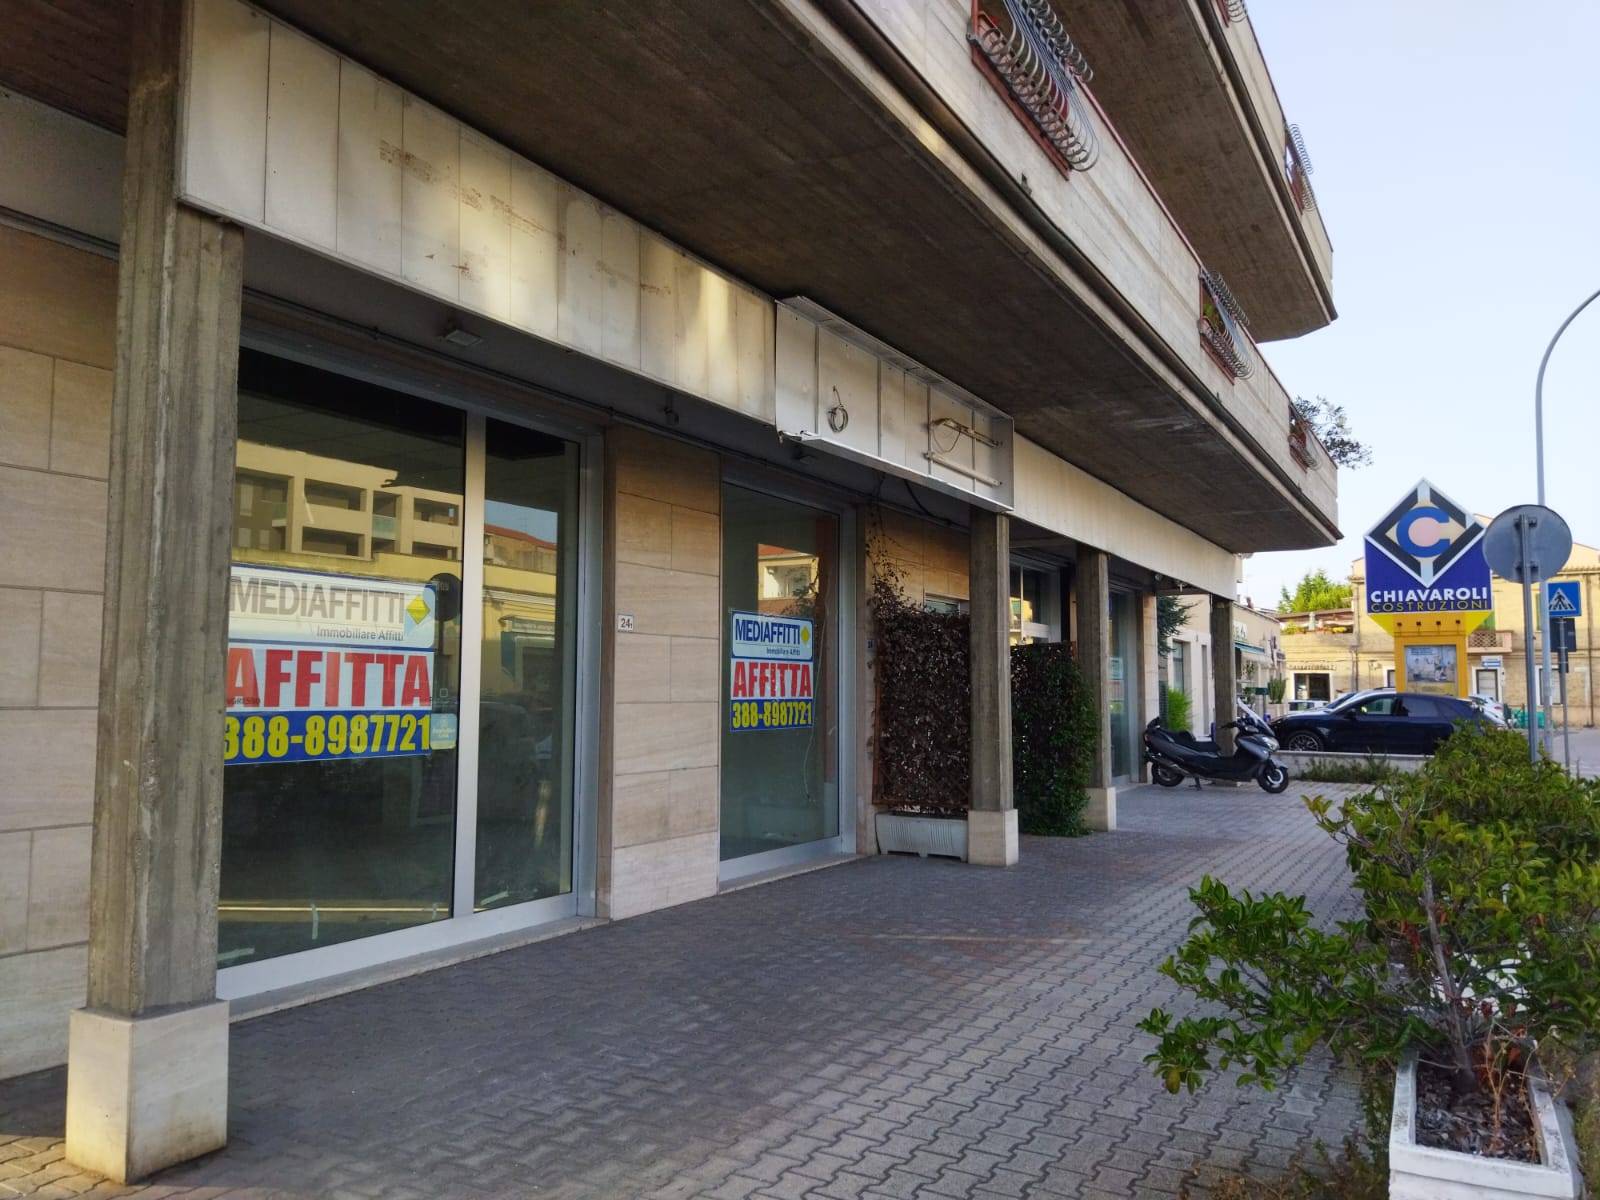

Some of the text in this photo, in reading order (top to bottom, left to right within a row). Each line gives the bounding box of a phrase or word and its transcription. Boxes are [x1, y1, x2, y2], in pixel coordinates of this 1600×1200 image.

[229, 576, 404, 624] MEDIAFFITTI
[1370, 587, 1488, 603] CHIAVAROLI
[1371, 600, 1488, 612] COSTRUZIONI
[316, 624, 404, 641] Immobiliare Affitti
[735, 619, 800, 645] MEDIAFFITTI
[226, 648, 431, 708] AFFITTA
[733, 662, 812, 697] AFFITTA
[733, 702, 812, 728] 388-8987721
[224, 714, 430, 760] 388-8987721
